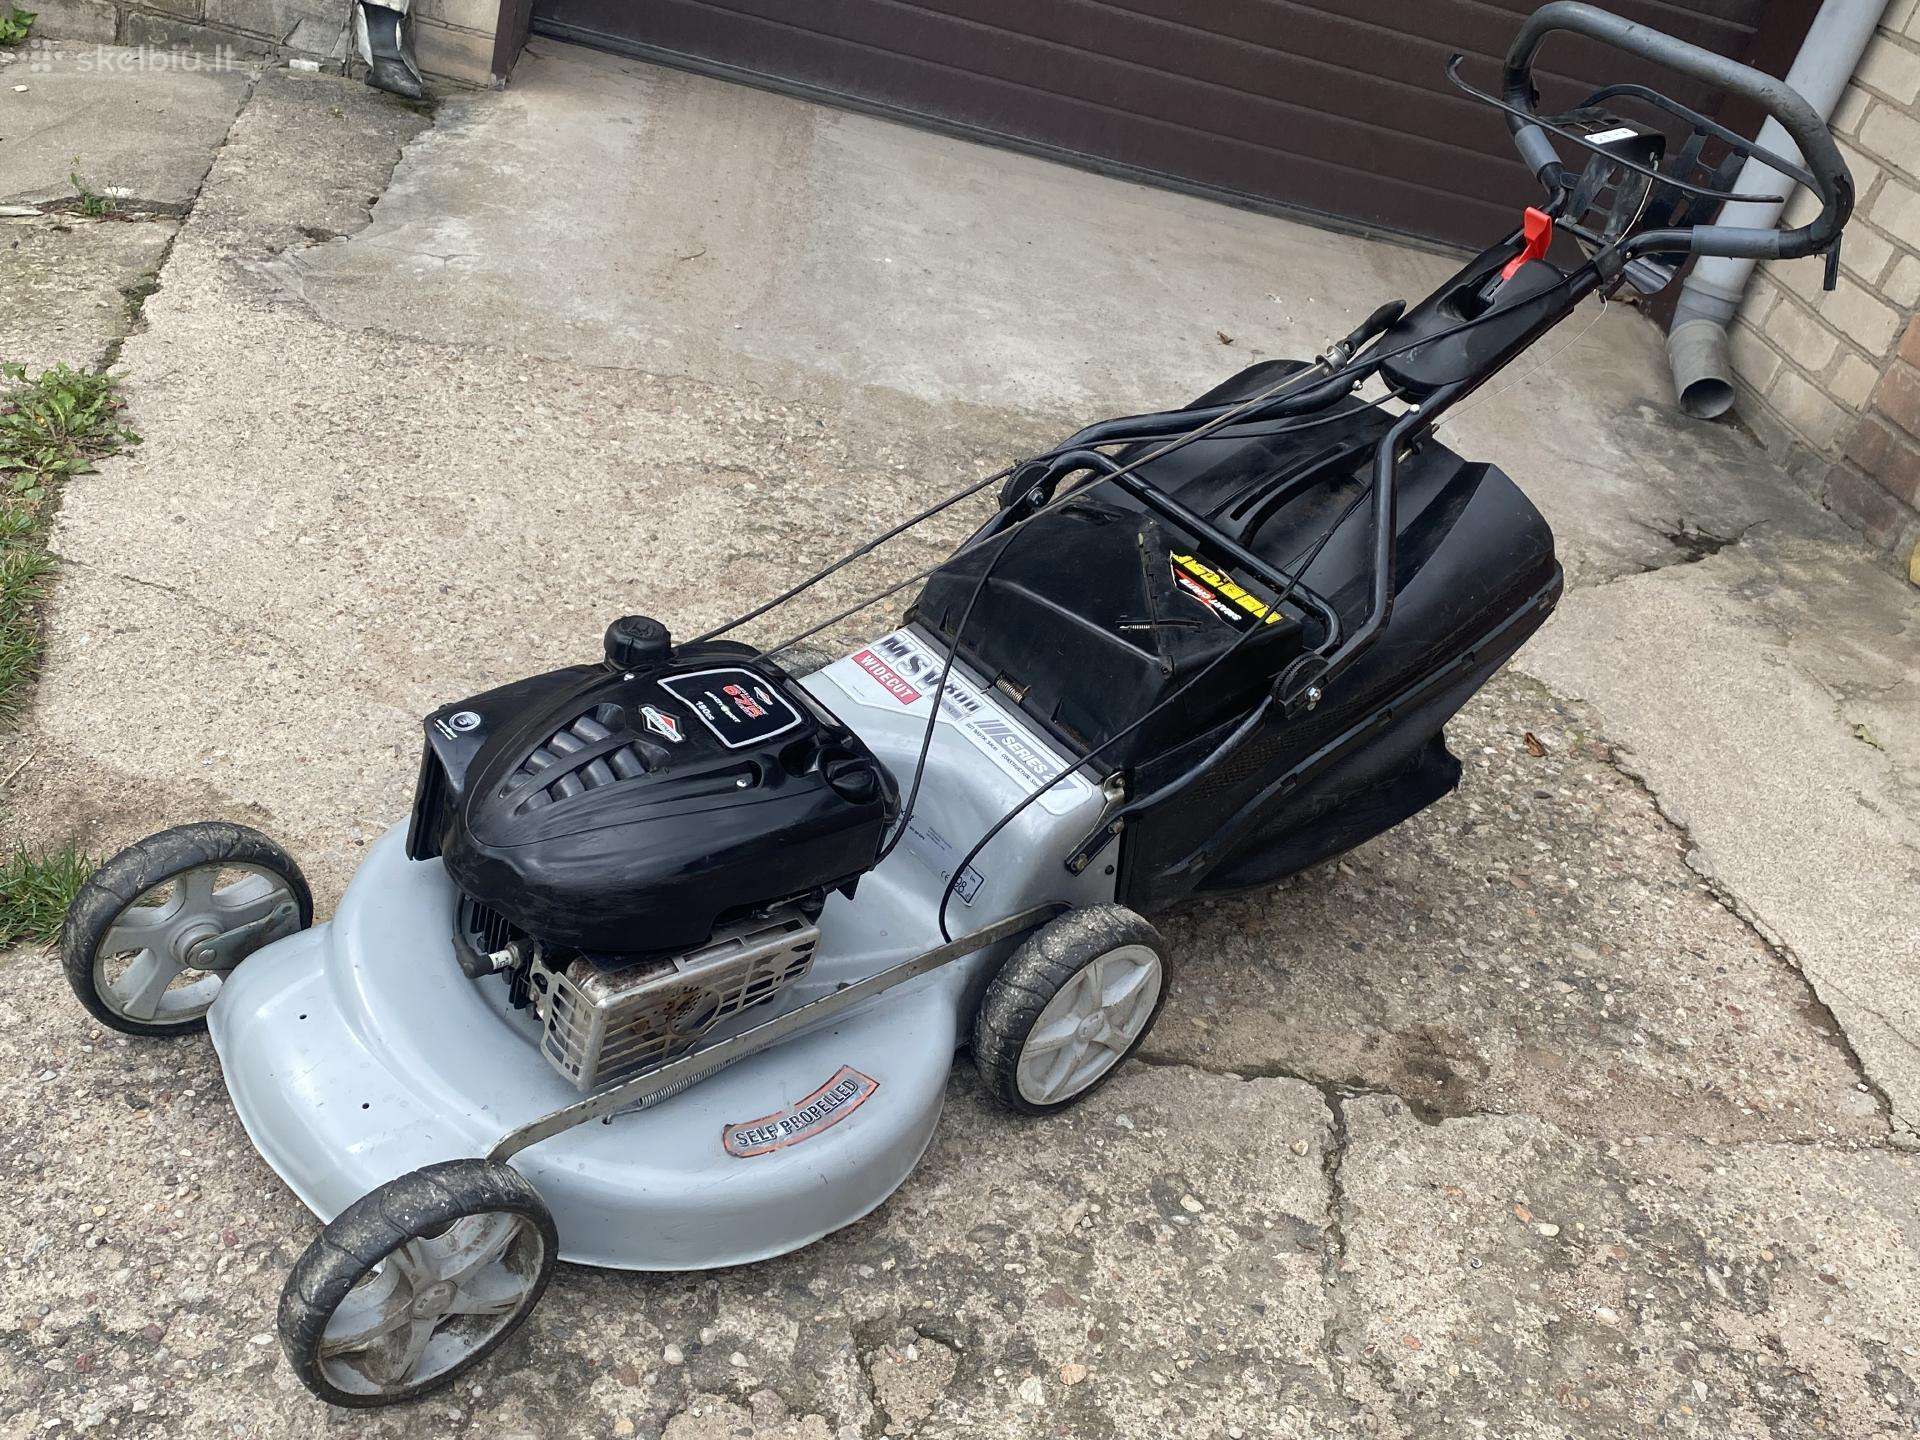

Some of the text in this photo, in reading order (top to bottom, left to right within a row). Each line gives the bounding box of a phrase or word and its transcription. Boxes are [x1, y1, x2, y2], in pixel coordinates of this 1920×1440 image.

[862, 655, 914, 698] WIDECUT
[1001, 735, 1048, 775] SERIES
[735, 1079, 859, 1146] SELF PROPELLED
